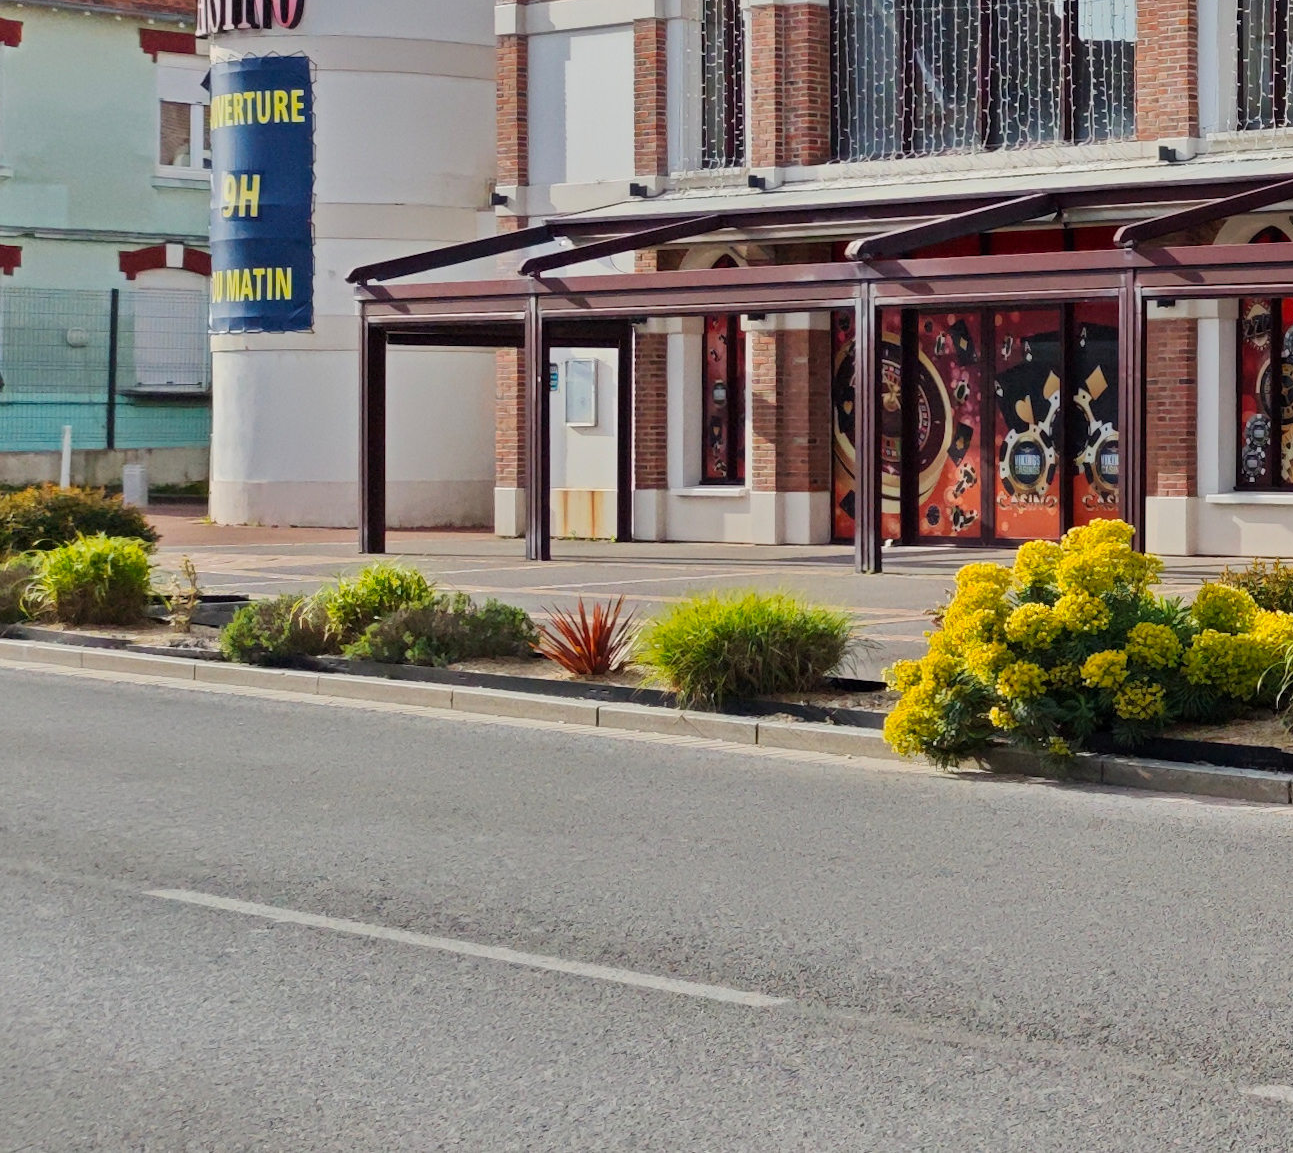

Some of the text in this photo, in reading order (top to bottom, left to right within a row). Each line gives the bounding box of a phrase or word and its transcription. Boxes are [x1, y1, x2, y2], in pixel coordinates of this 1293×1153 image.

[222, 173, 260, 218] 9H
[226, 267, 292, 302] MATIN
[1082, 493, 1119, 511] CASI
